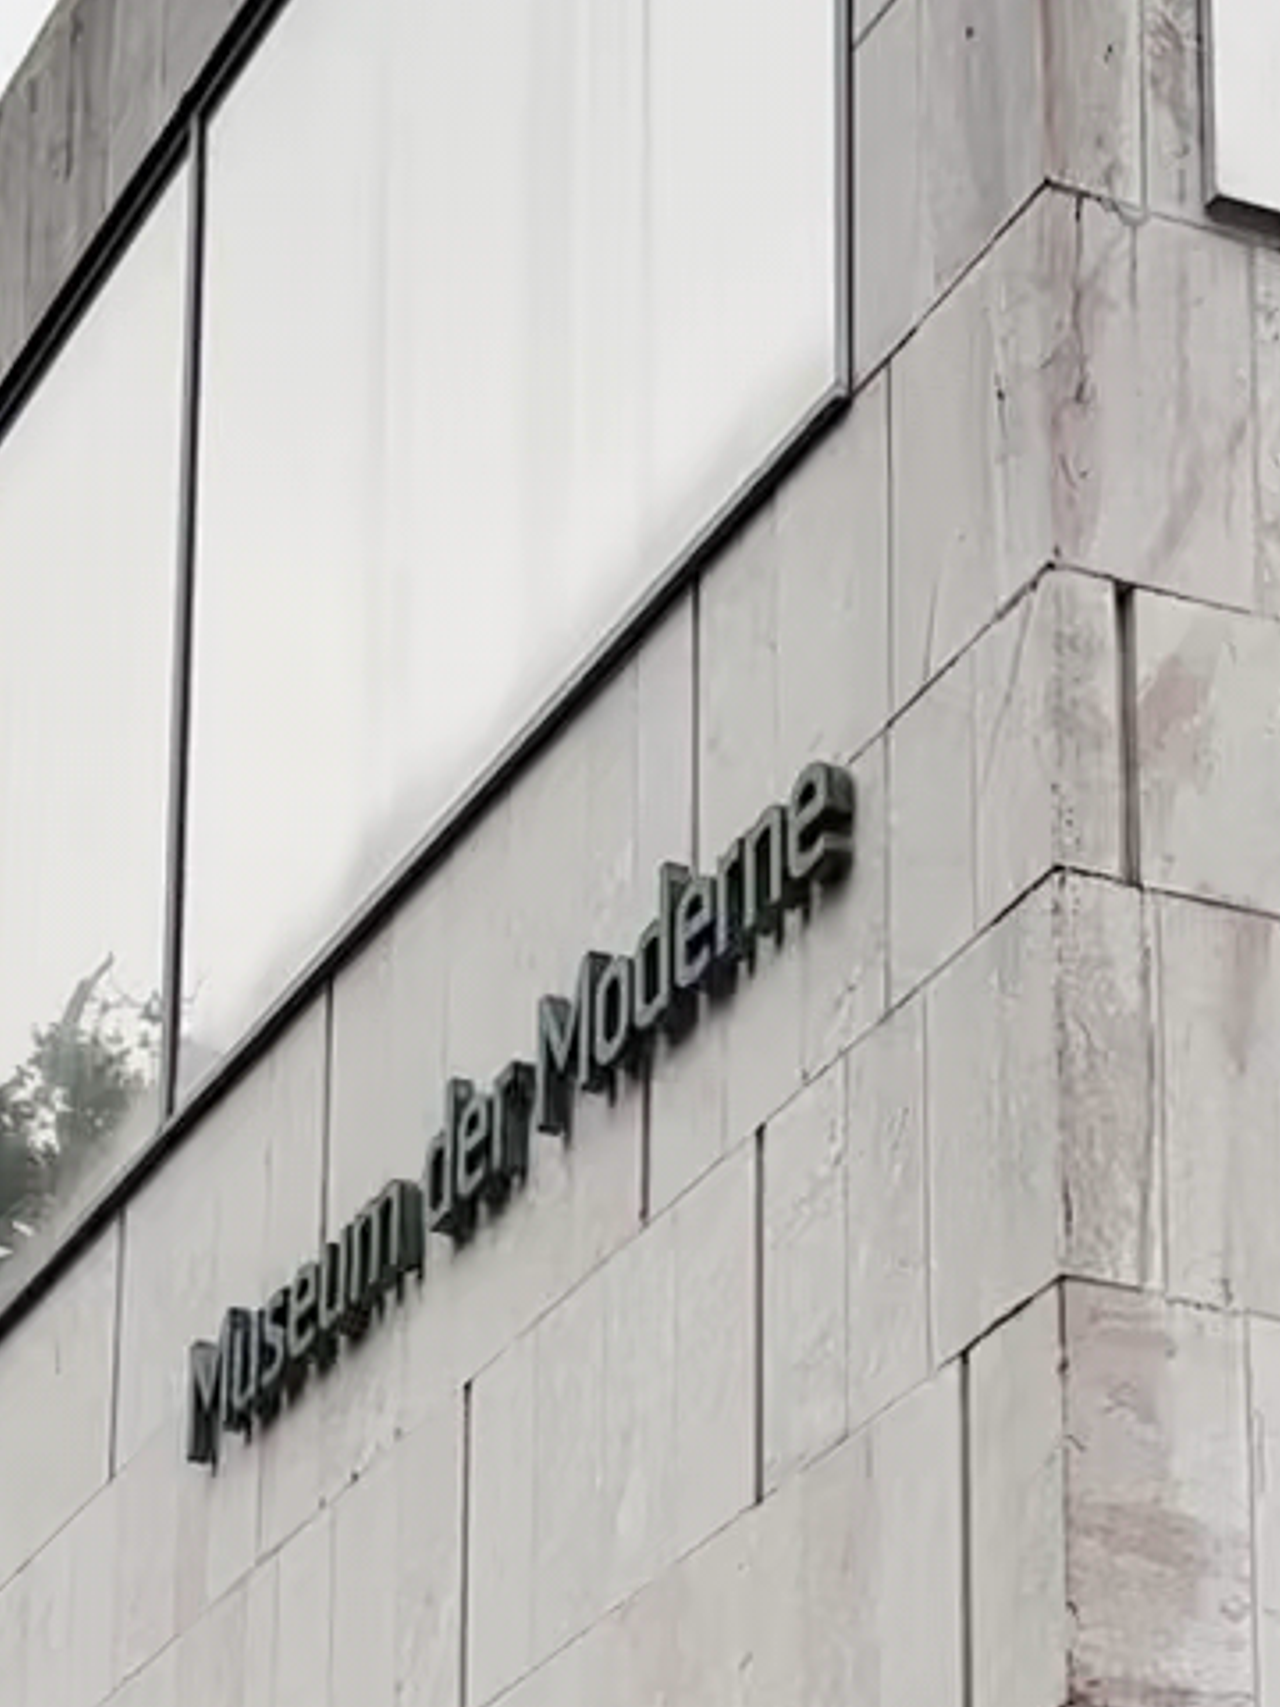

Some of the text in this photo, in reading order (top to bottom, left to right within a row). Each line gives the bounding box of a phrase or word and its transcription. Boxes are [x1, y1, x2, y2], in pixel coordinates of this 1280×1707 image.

[187, 761, 857, 1465] Museum der Moderne
